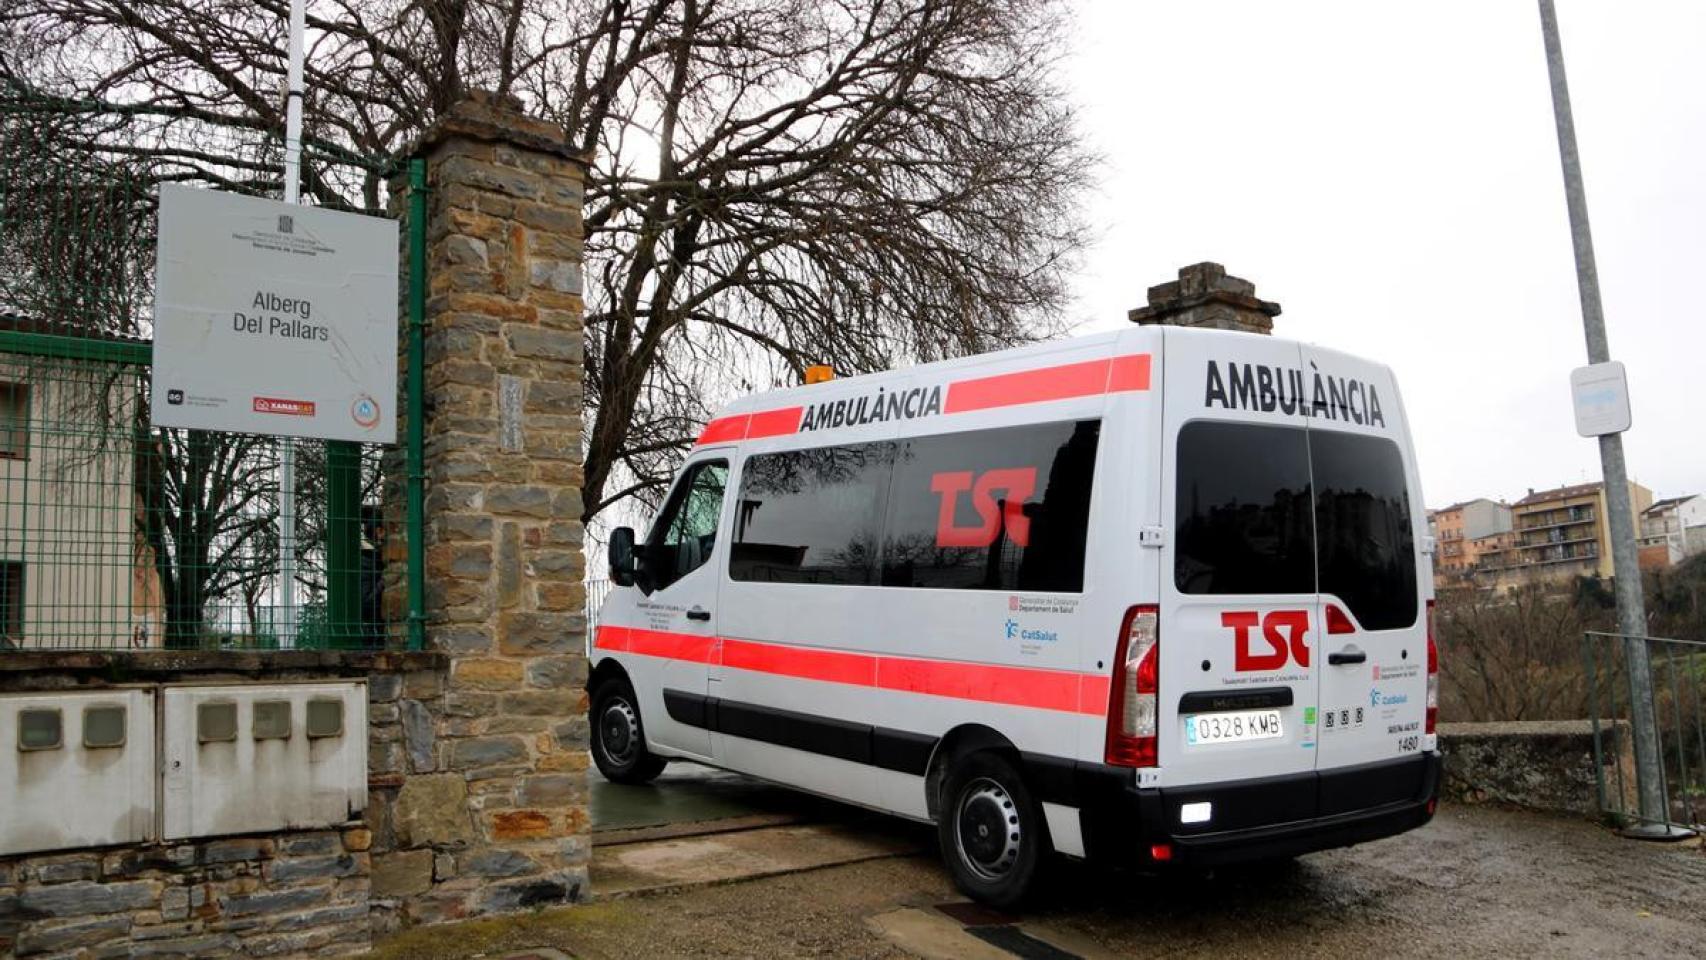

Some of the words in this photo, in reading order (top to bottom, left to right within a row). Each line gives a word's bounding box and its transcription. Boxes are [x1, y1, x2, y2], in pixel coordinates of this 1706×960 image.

[253, 291, 311, 319] Alberg
[234, 312, 263, 334] Del
[269, 316, 328, 342] Pallars
[800, 386, 942, 433] AMBULÀNCIA
[1205, 360, 1386, 429] AMBULÀNCIA
[1199, 716, 1244, 739] 0328
[1248, 713, 1280, 736] KMB
